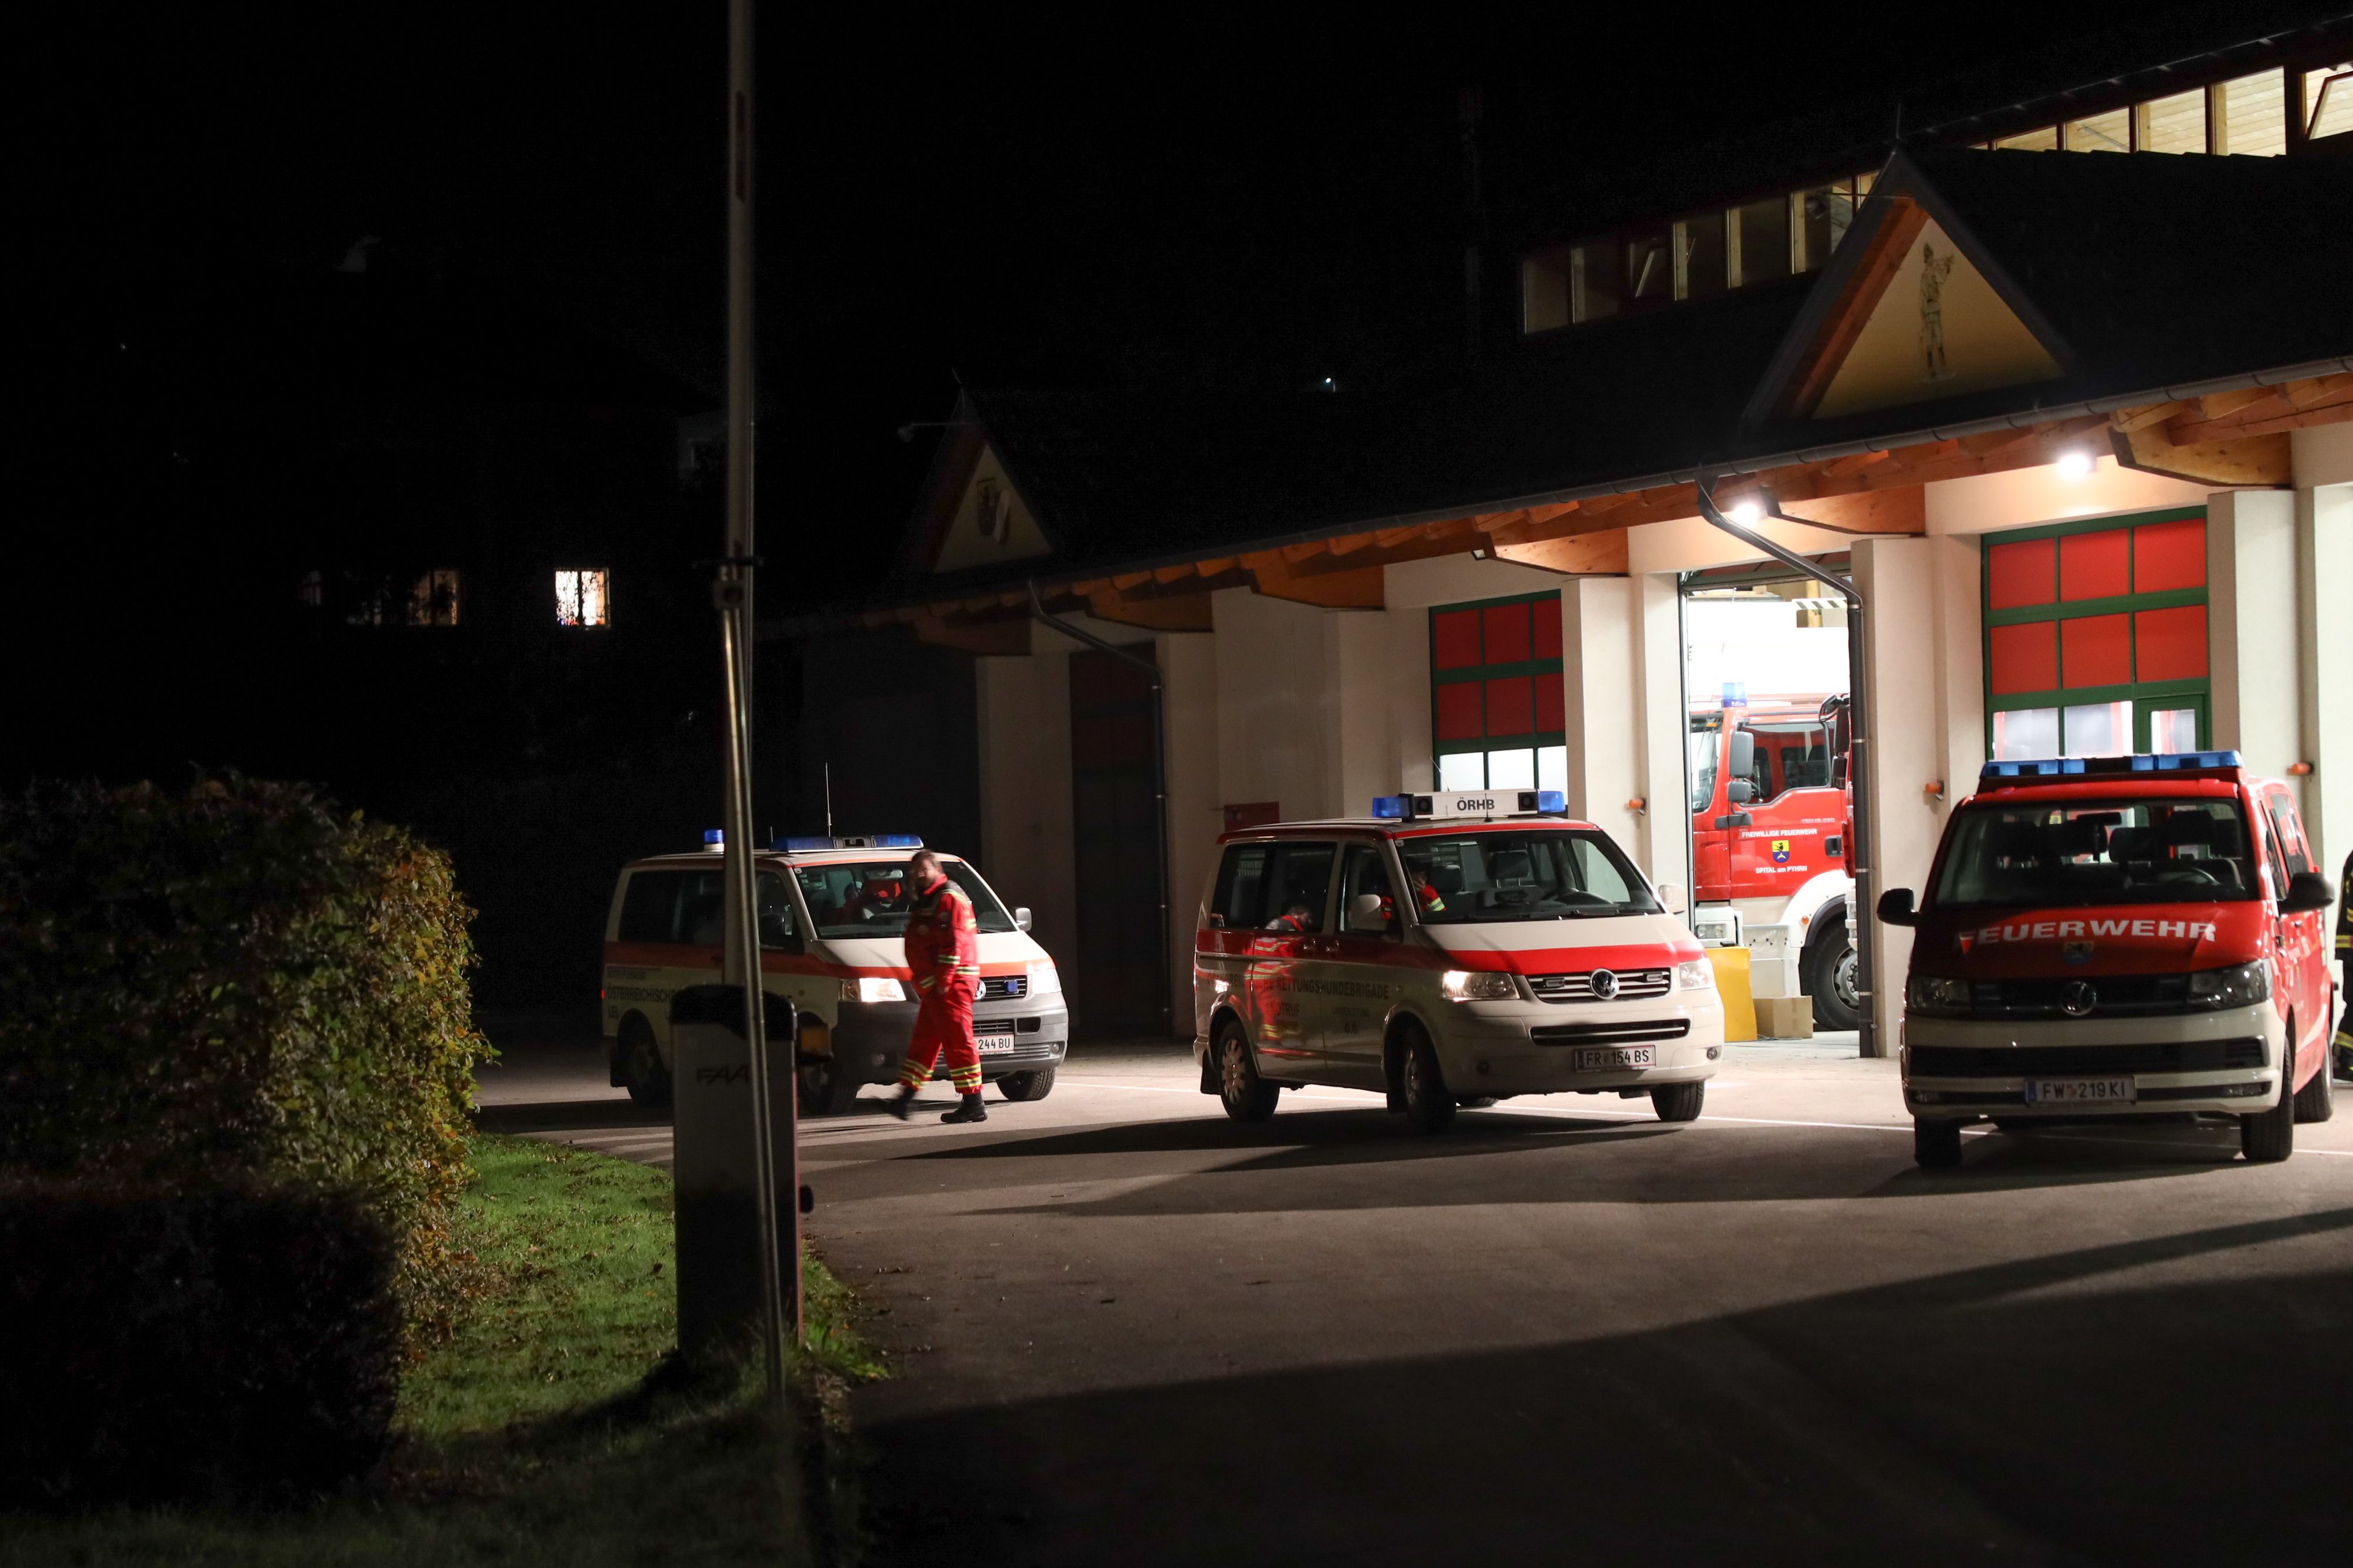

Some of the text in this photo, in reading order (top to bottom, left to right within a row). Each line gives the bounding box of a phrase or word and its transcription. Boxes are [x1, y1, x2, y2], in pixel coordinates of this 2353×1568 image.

[1457, 797, 1495, 810] ÖRHB
[1955, 920, 2216, 949] FEUERWEHR
[1277, 978, 1389, 999] RETTUNGSHUNDEBRIGADE
[978, 1038, 1010, 1049] 244 BU
[1587, 1050, 1649, 1065] FR 154 BS
[696, 1065, 750, 1083] FAA
[2043, 1082, 2125, 1099] FW 219 KI
